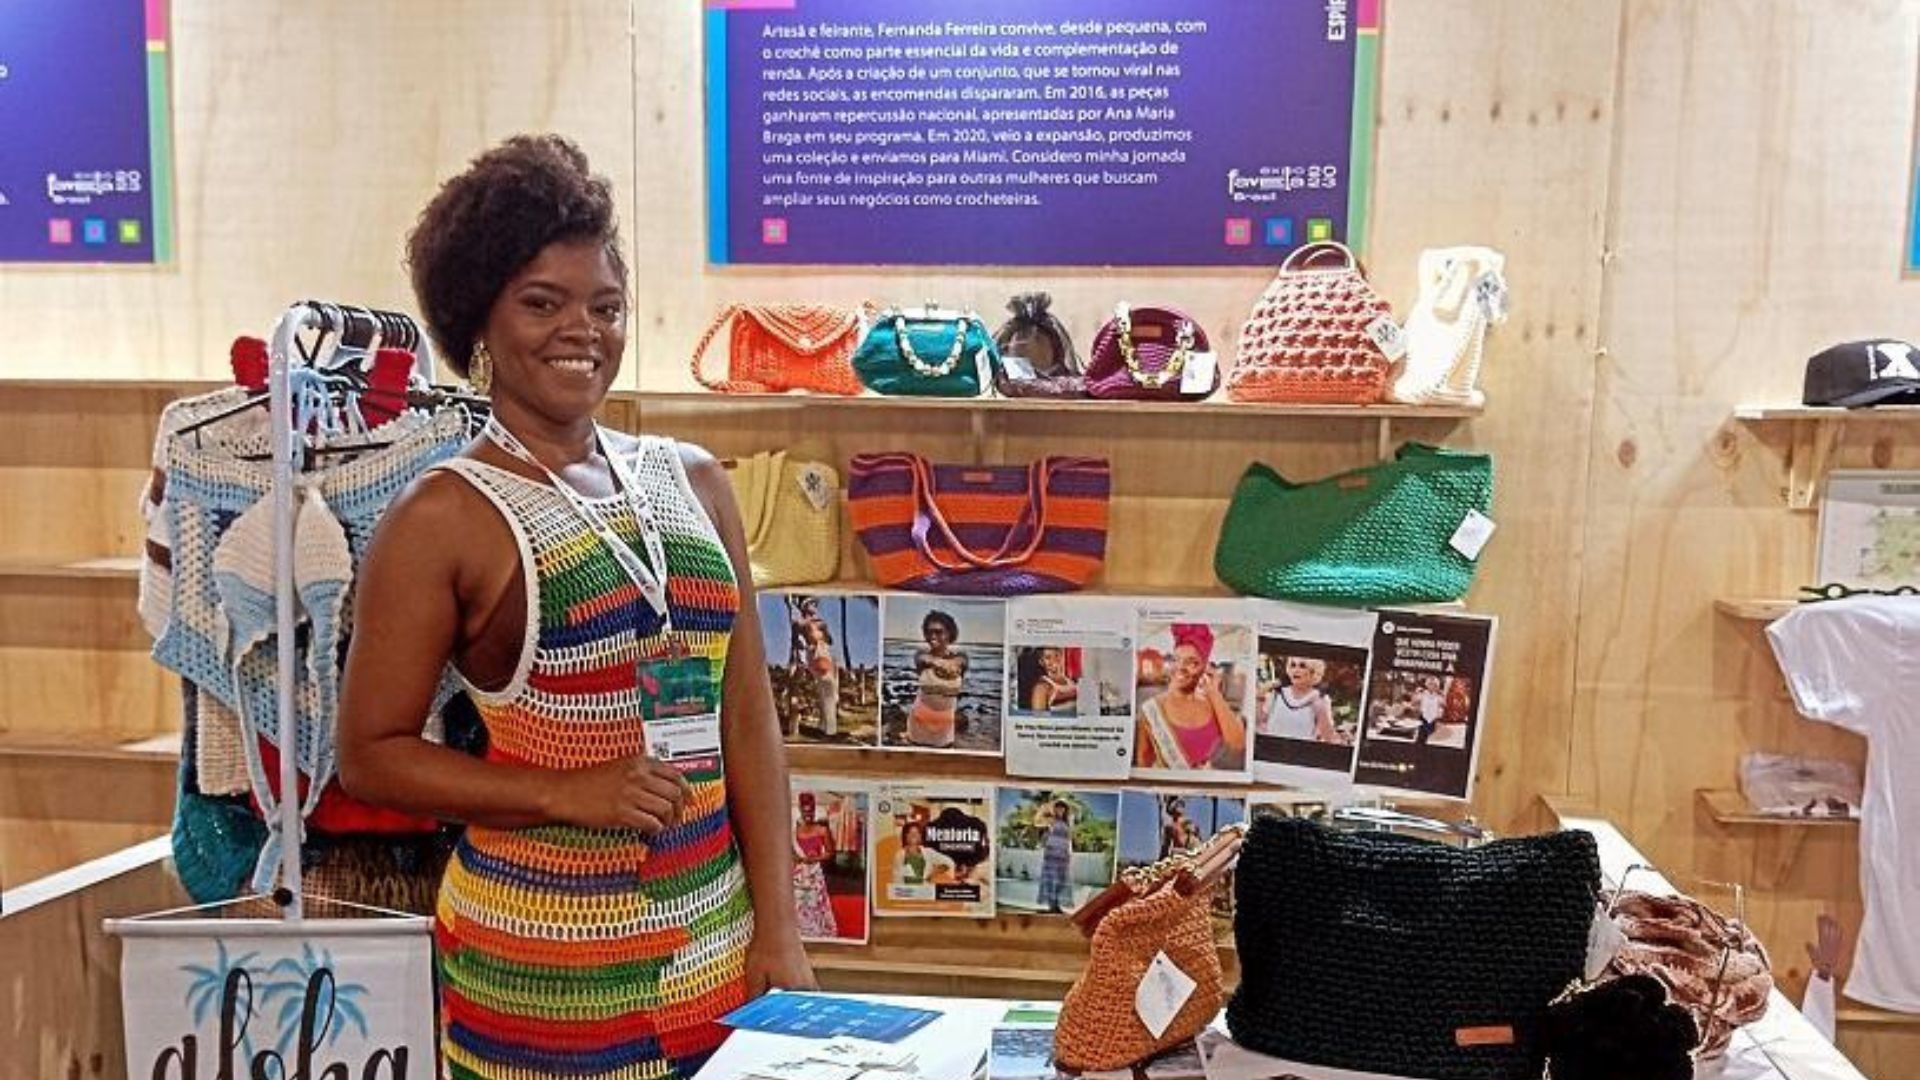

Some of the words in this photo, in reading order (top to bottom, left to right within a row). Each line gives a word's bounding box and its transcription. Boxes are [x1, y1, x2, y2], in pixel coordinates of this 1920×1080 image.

[762, 22, 806, 38] Artesã
[807, 26, 818, 38] e
[819, 22, 875, 38] feirante,
[878, 22, 943, 38] Fernanda
[944, 21, 997, 36] Ferreira
[999, 21, 1056, 36] convive,
[1059, 19, 1103, 36] desde
[1106, 21, 1172, 37] pequena,
[1174, 20, 1207, 33] com
[762, 48, 773, 60] o
[774, 45, 821, 60] crochê
[823, 47, 863, 59] como
[866, 46, 902, 61] parte
[904, 44, 967, 58] essencial
[969, 43, 987, 57] da
[991, 42, 1019, 57] vida
[1022, 45, 1031, 57] e
[1034, 41, 1158, 59] complementação
[1159, 40, 1179, 55] de
[762, 67, 804, 81] renda.
[807, 66, 843, 82] Após
[845, 68, 854, 81] a
[856, 66, 906, 82] criação
[908, 65, 926, 80] de
[929, 68, 952, 79] um
[955, 65, 1020, 81] conjunto,
[1023, 66, 1051, 81] que
[1054, 66, 1069, 78] se
[1071, 65, 1120, 78] tornou
[1123, 62, 1153, 77] viral
[1155, 64, 1181, 77] nas
[762, 87, 800, 102] redes
[802, 88, 851, 102] sociais,
[852, 90, 868, 102] as
[870, 86, 958, 102] encomendas
[960, 86, 1041, 102] dispararam.
[1044, 84, 1066, 100] Em
[1069, 85, 1108, 99] 2016,
[1109, 87, 1125, 99] as
[1128, 86, 1170, 101] peças
[762, 108, 832, 126] ganharam
[833, 108, 916, 125] repercussão
[918, 107, 979, 122] nacional,
[982, 107, 1075, 124] apresentadas
[1077, 108, 1102, 123] por
[1104, 106, 1133, 121] Ana
[1135, 105, 1176, 121] Maria
[762, 129, 802, 147] Braga
[804, 132, 826, 144] em
[828, 132, 852, 144] seu
[855, 131, 923, 146] programa.
[927, 128, 950, 143] Em
[953, 128, 990, 143] 2020,
[993, 128, 1022, 142] veio
[1024, 130, 1033, 142] a
[1036, 128, 1106, 145] expansão,
[1108, 128, 1193, 145] produzimos
[762, 153, 793, 165] uma
[795, 150, 848, 167] coleção
[850, 153, 859, 164] e
[861, 152, 927, 165] enviamos
[929, 152, 960, 167] para
[963, 149, 1009, 164] Miami.
[1011, 149, 1082, 164] Considero
[1085, 149, 1129, 163] minha
[1131, 148, 1187, 166] jornada
[762, 173, 793, 185] uma
[795, 170, 832, 185] fonte
[833, 171, 852, 185] de
[854, 171, 924, 187] inspiração
[926, 173, 957, 188] para
[959, 172, 1003, 185] outras
[1005, 170, 1071, 185] mulheres
[1072, 172, 1101, 187] que
[1102, 170, 1158, 185] buscam
[762, 191, 814, 209] ampliar
[816, 194, 847, 206] seus
[849, 192, 911, 209] negócios
[912, 194, 953, 206] como
[954, 191, 1041, 206] crocheteiras.
[925, 826, 981, 842] Mentoria
